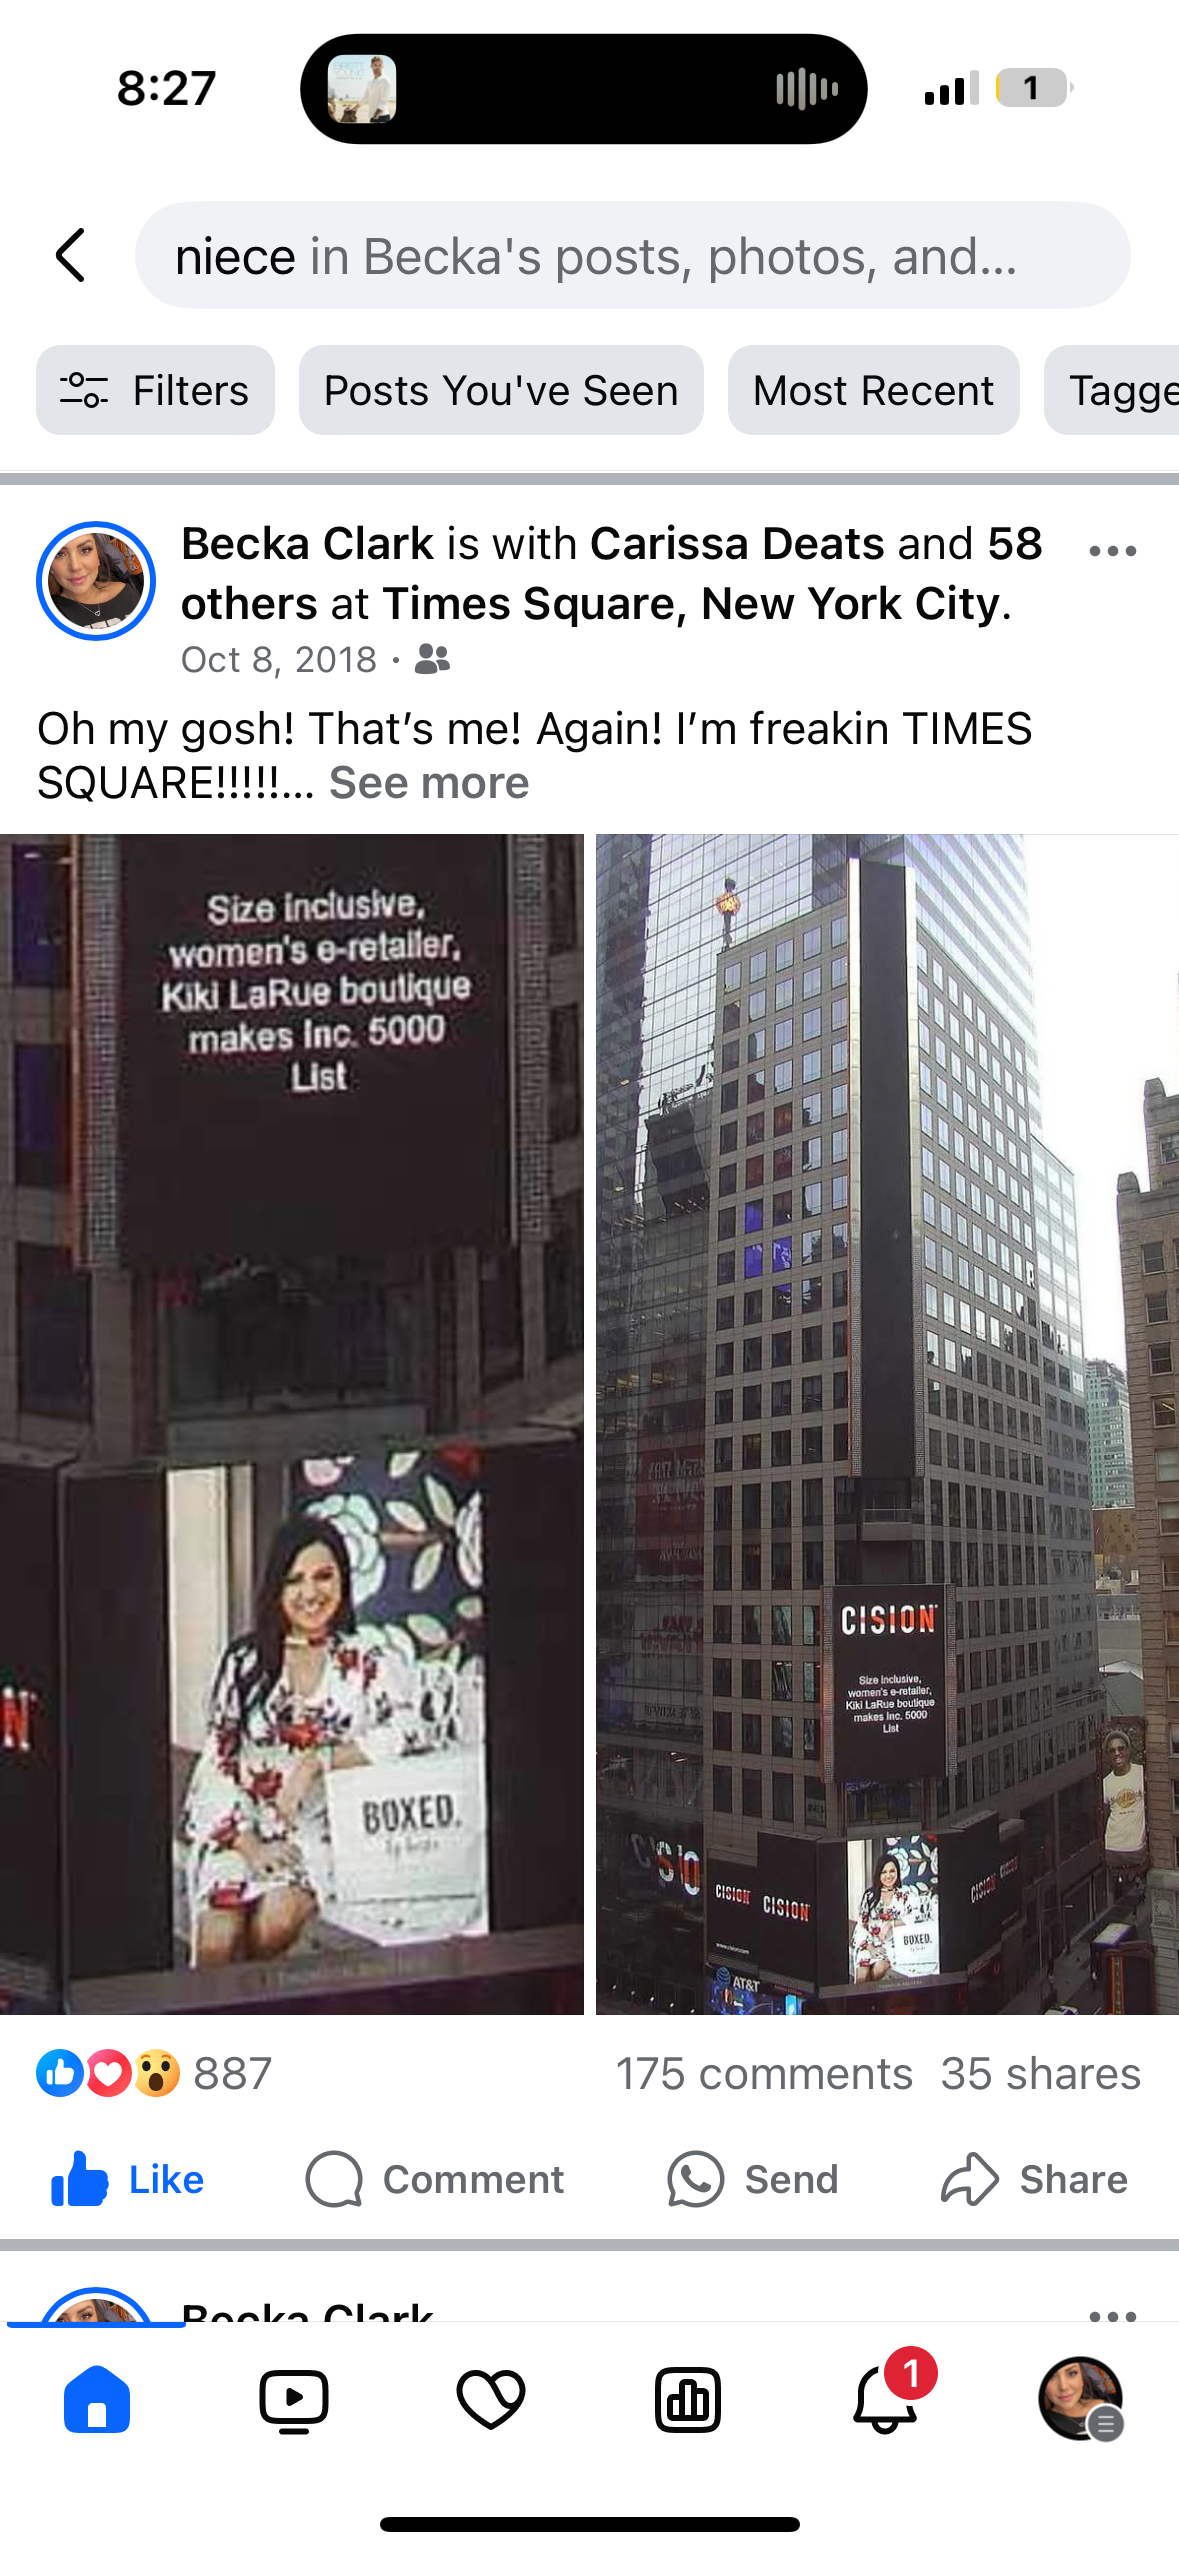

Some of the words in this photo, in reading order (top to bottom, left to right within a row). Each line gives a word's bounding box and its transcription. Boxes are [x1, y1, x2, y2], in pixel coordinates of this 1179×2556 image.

[118, 70, 216, 106] 8:27
[1024, 76, 1036, 100] 1
[178, 237, 295, 275] niece
[312, 237, 347, 275] in
[366, 237, 540, 276] Becka's
[558, 240, 690, 283] posts,
[711, 237, 875, 283] photos,
[894, 237, 1015, 276] and...
[135, 374, 248, 406] Filters
[326, 375, 428, 406] Posts
[442, 375, 569, 406] You've
[584, 374, 677, 406] Seen
[755, 375, 847, 406] Most
[863, 375, 994, 406] Recent
[184, 525, 308, 560] Becka
[324, 525, 434, 560] Clark
[449, 525, 478, 560] is
[492, 525, 575, 560] with
[591, 524, 747, 560] Carissa
[765, 527, 884, 560] Deats
[899, 526, 971, 560] and
[989, 526, 1042, 560] 58
[182, 585, 317, 620] others
[332, 589, 369, 620] at
[383, 584, 510, 620] Times
[524, 586, 685, 628] Square,
[704, 587, 795, 620] New
[807, 585, 902, 620] York
[916, 584, 1010, 628] City.
[182, 646, 240, 674] Oct
[253, 646, 280, 680] 8,
[297, 646, 376, 674] 2018
[39, 711, 93, 745] Oh
[110, 720, 168, 753] my
[182, 711, 292, 753] gosh!
[309, 711, 432, 745] That’s
[449, 712, 519, 745] me!
[536, 710, 660, 753] Again!
[679, 712, 735, 745] I’m
[750, 710, 887, 745] freakin
[903, 711, 1031, 745] TIMES
[330, 765, 408, 799] See
[423, 773, 529, 799] more
[207, 895, 276, 926] Size
[284, 888, 425, 922] inclusive,
[169, 935, 308, 968] women's
[317, 929, 461, 962] e-retailer,
[161, 980, 220, 1012] Kiki
[229, 977, 331, 1010] LaRue
[339, 972, 471, 1006] boutique
[189, 1023, 293, 1054] makes
[304, 1019, 358, 1048] Inc.
[368, 1014, 445, 1046] 5000
[292, 1061, 348, 1091] List
[842, 1604, 938, 1635] CISION
[848, 1688, 888, 1698] women's
[859, 1675, 879, 1685] Size
[881, 1674, 922, 1684] inclusive,
[845, 1701, 863, 1710] Kiki
[865, 1700, 895, 1710] LaRue
[897, 1698, 935, 1709] boutique
[854, 1712, 884, 1723] makes
[886, 1711, 902, 1721] Inc.
[905, 1710, 928, 1720] 5000
[883, 1724, 899, 1733] List
[363, 1794, 462, 1834] BOXED.
[715, 1884, 751, 1905] CISION
[763, 1895, 810, 1922] CISION
[733, 1976, 760, 1992] AT&T
[195, 2057, 271, 2090] 887
[618, 2057, 684, 2090] 175
[700, 2059, 912, 2090] comments
[942, 2057, 991, 2090] 35
[1007, 2056, 1140, 2090] shares
[131, 2163, 203, 2194] Like
[384, 2165, 564, 2194] Comment
[746, 2164, 837, 2194] Send
[1021, 2164, 1127, 2194] Share
[904, 2360, 916, 2388] 1
